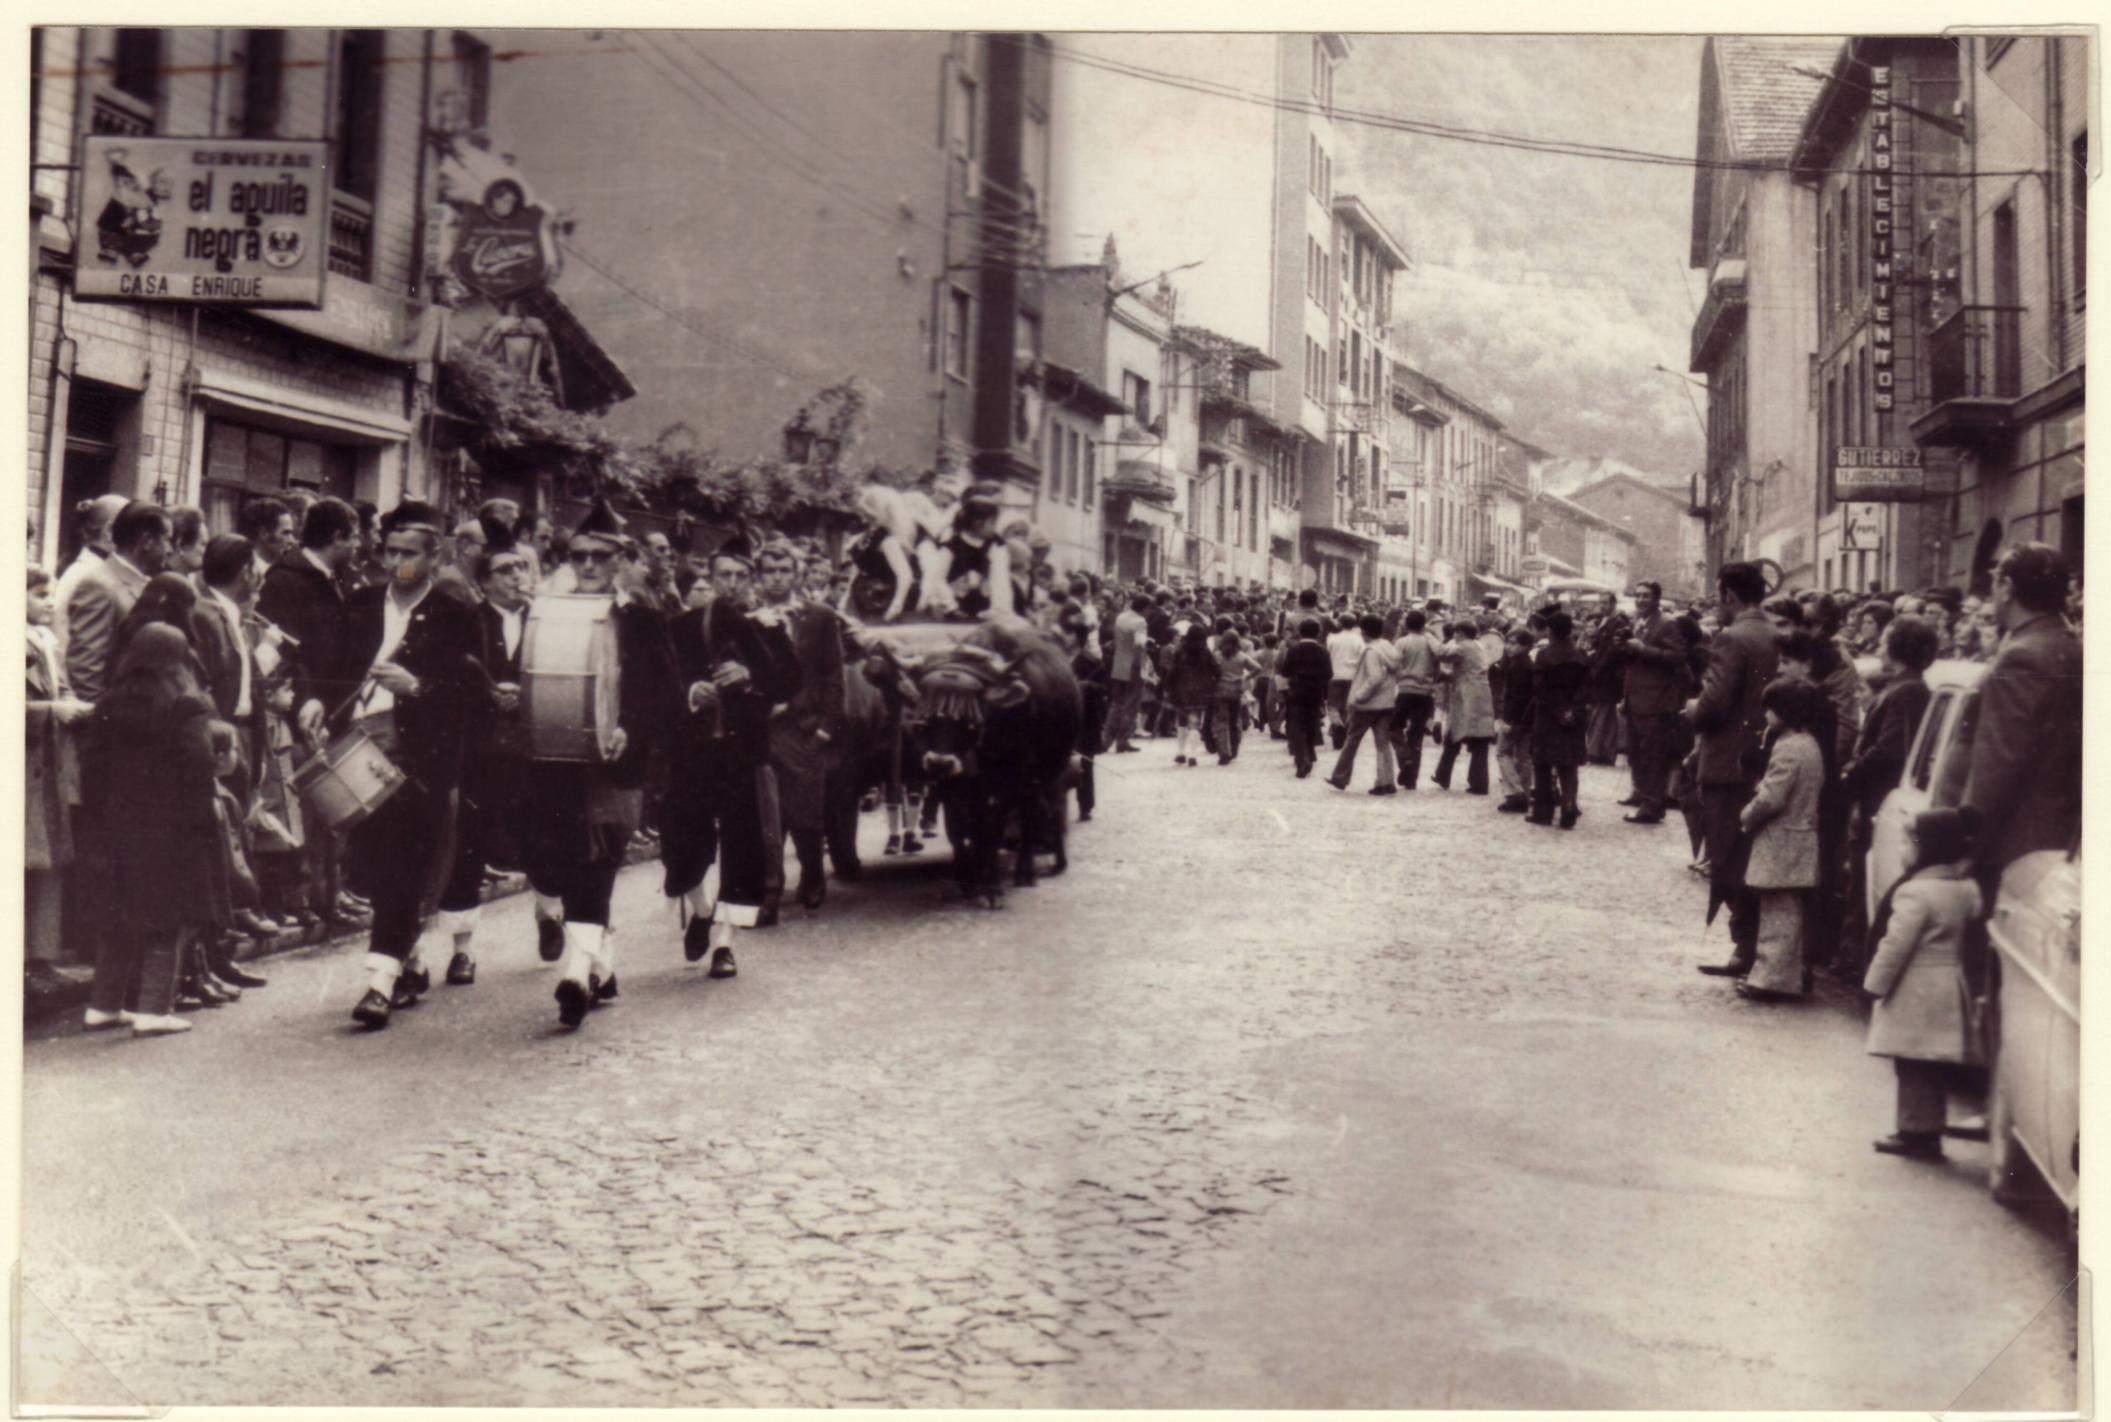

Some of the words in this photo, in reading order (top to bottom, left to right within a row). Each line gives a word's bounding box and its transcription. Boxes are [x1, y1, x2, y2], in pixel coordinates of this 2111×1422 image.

[192, 151, 312, 167] CERVEZAS
[188, 171, 214, 212] el
[185, 225, 262, 272] negra
[1872, 67, 1892, 408] ESTABLECIMIENTOS
[119, 273, 169, 295] CASA
[192, 276, 263, 297] ENRIQUE
[1838, 448, 1921, 466] GUTIERREZ
